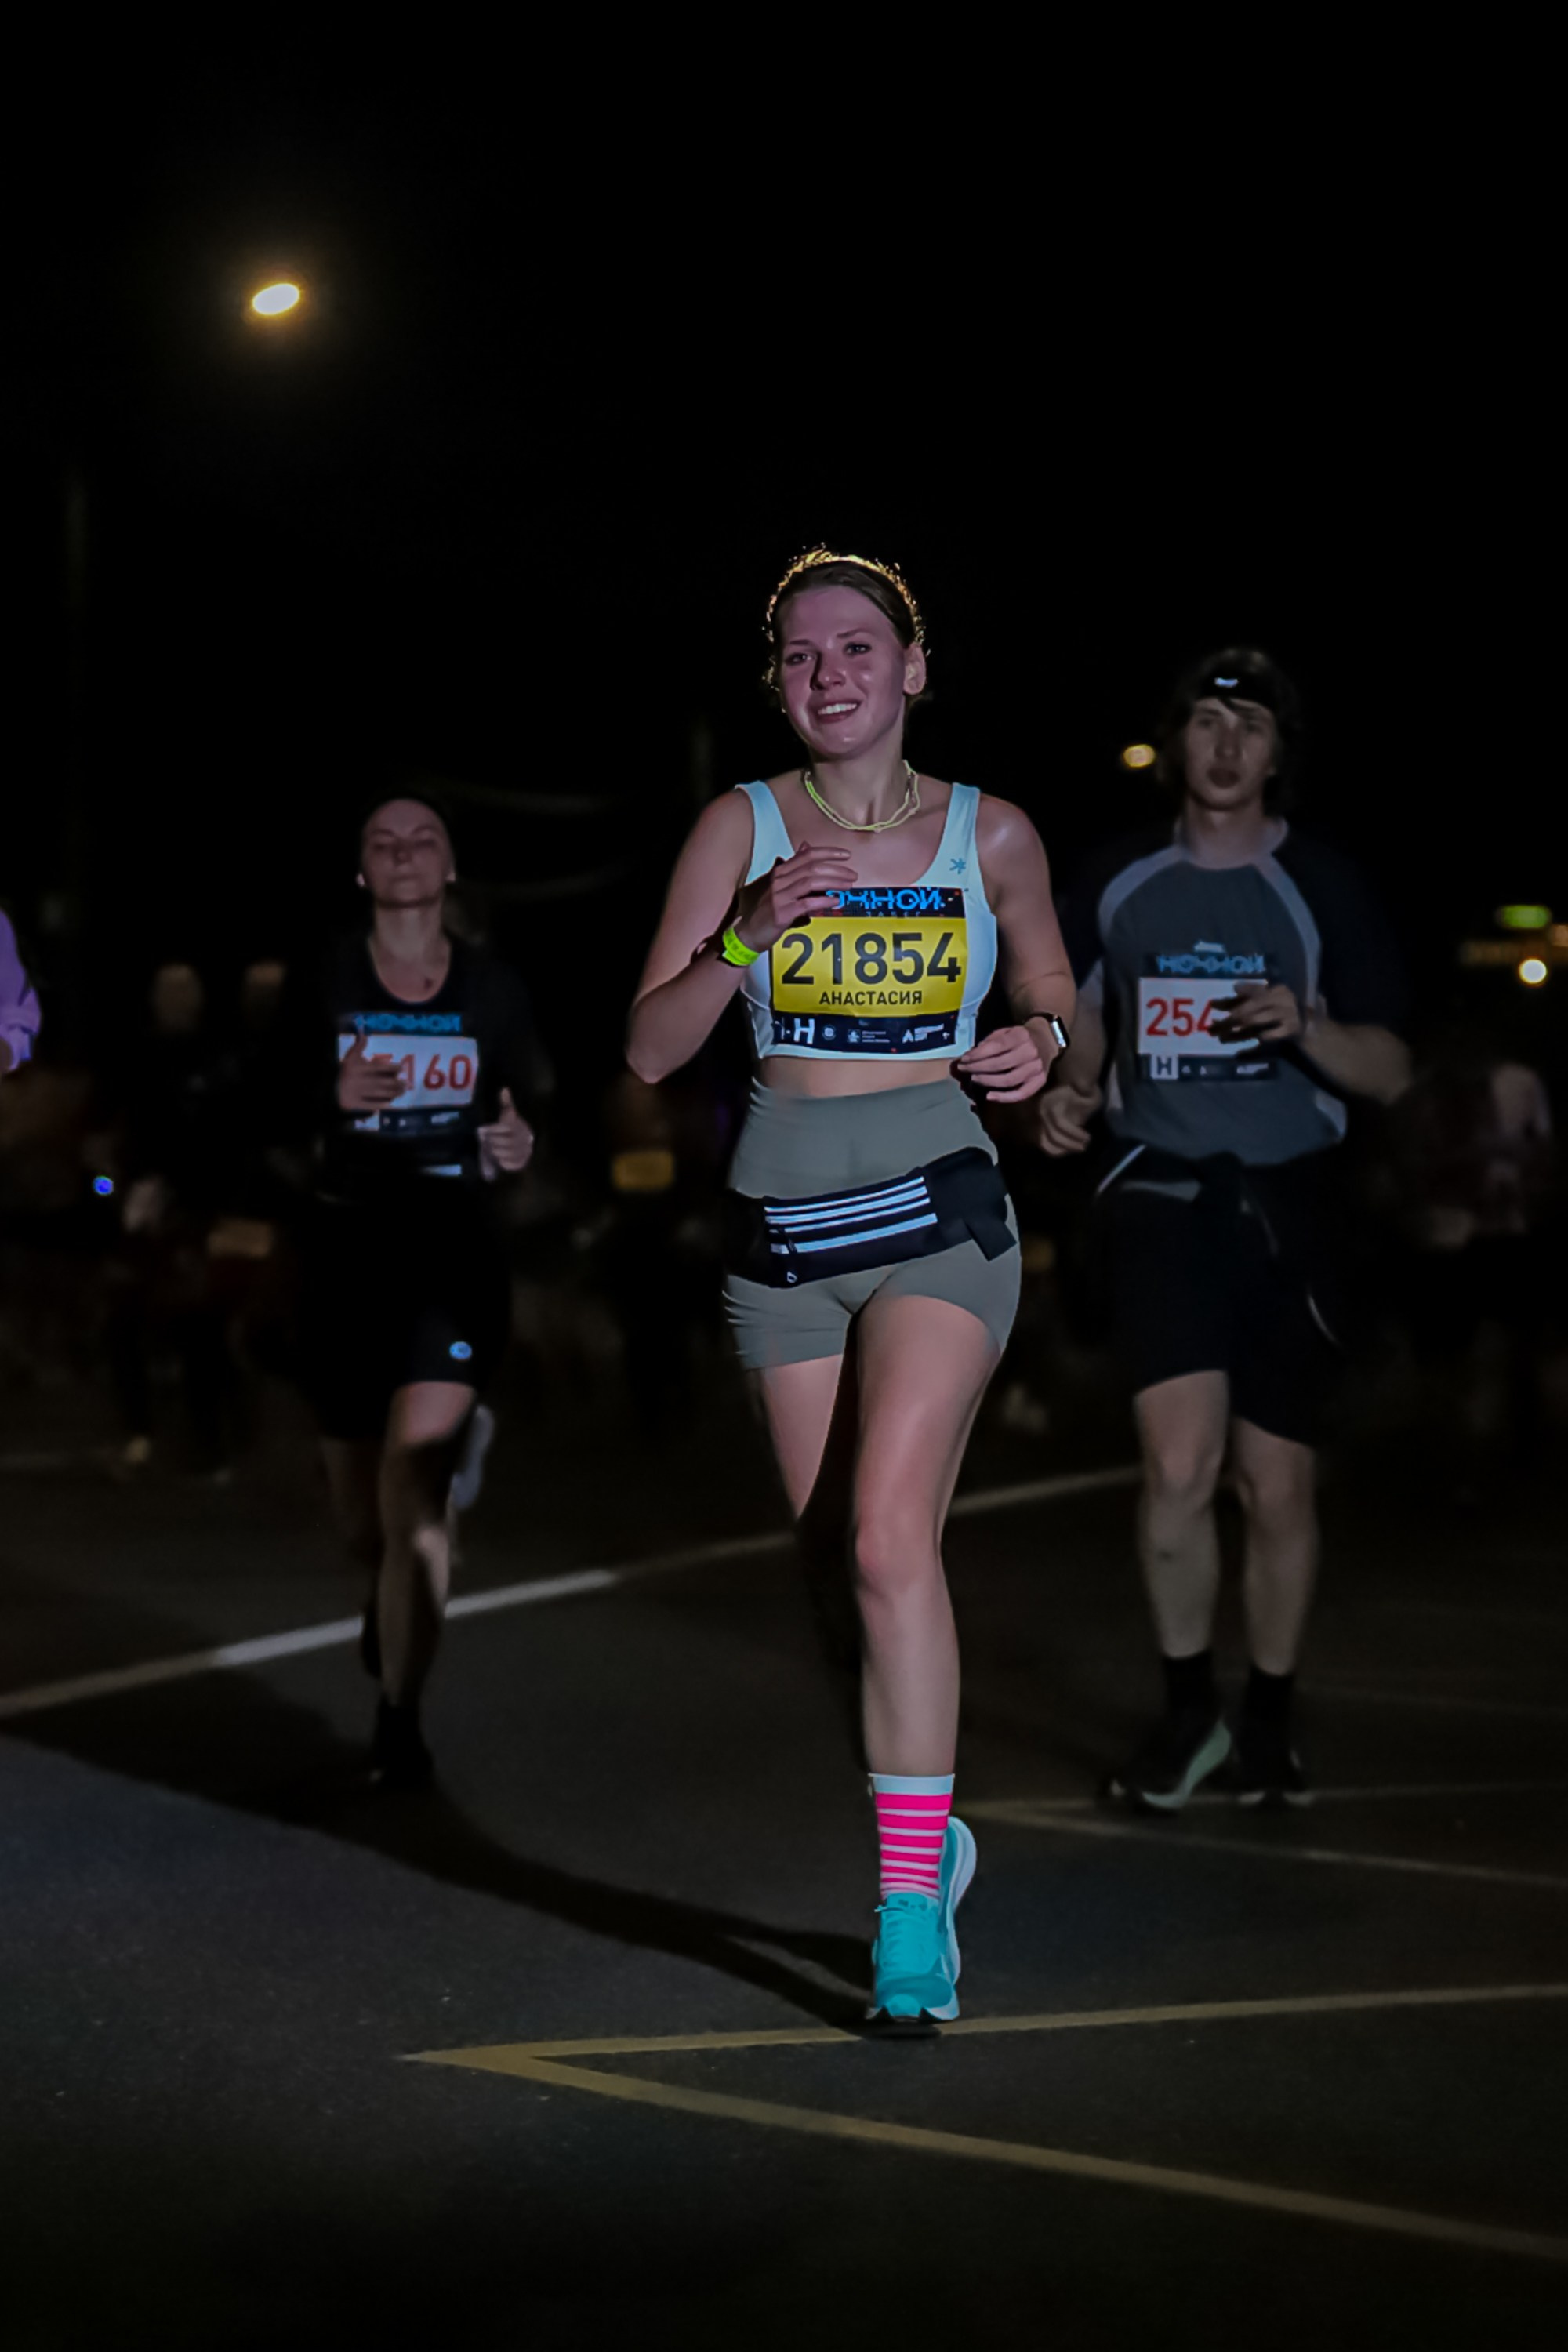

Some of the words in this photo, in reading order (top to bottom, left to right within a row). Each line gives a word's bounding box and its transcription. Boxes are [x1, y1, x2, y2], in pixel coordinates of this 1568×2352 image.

[781, 932, 961, 985] 21854
[819, 990, 923, 1005] АНАСТАСИЯ
[372, 1053, 472, 1091] 160
